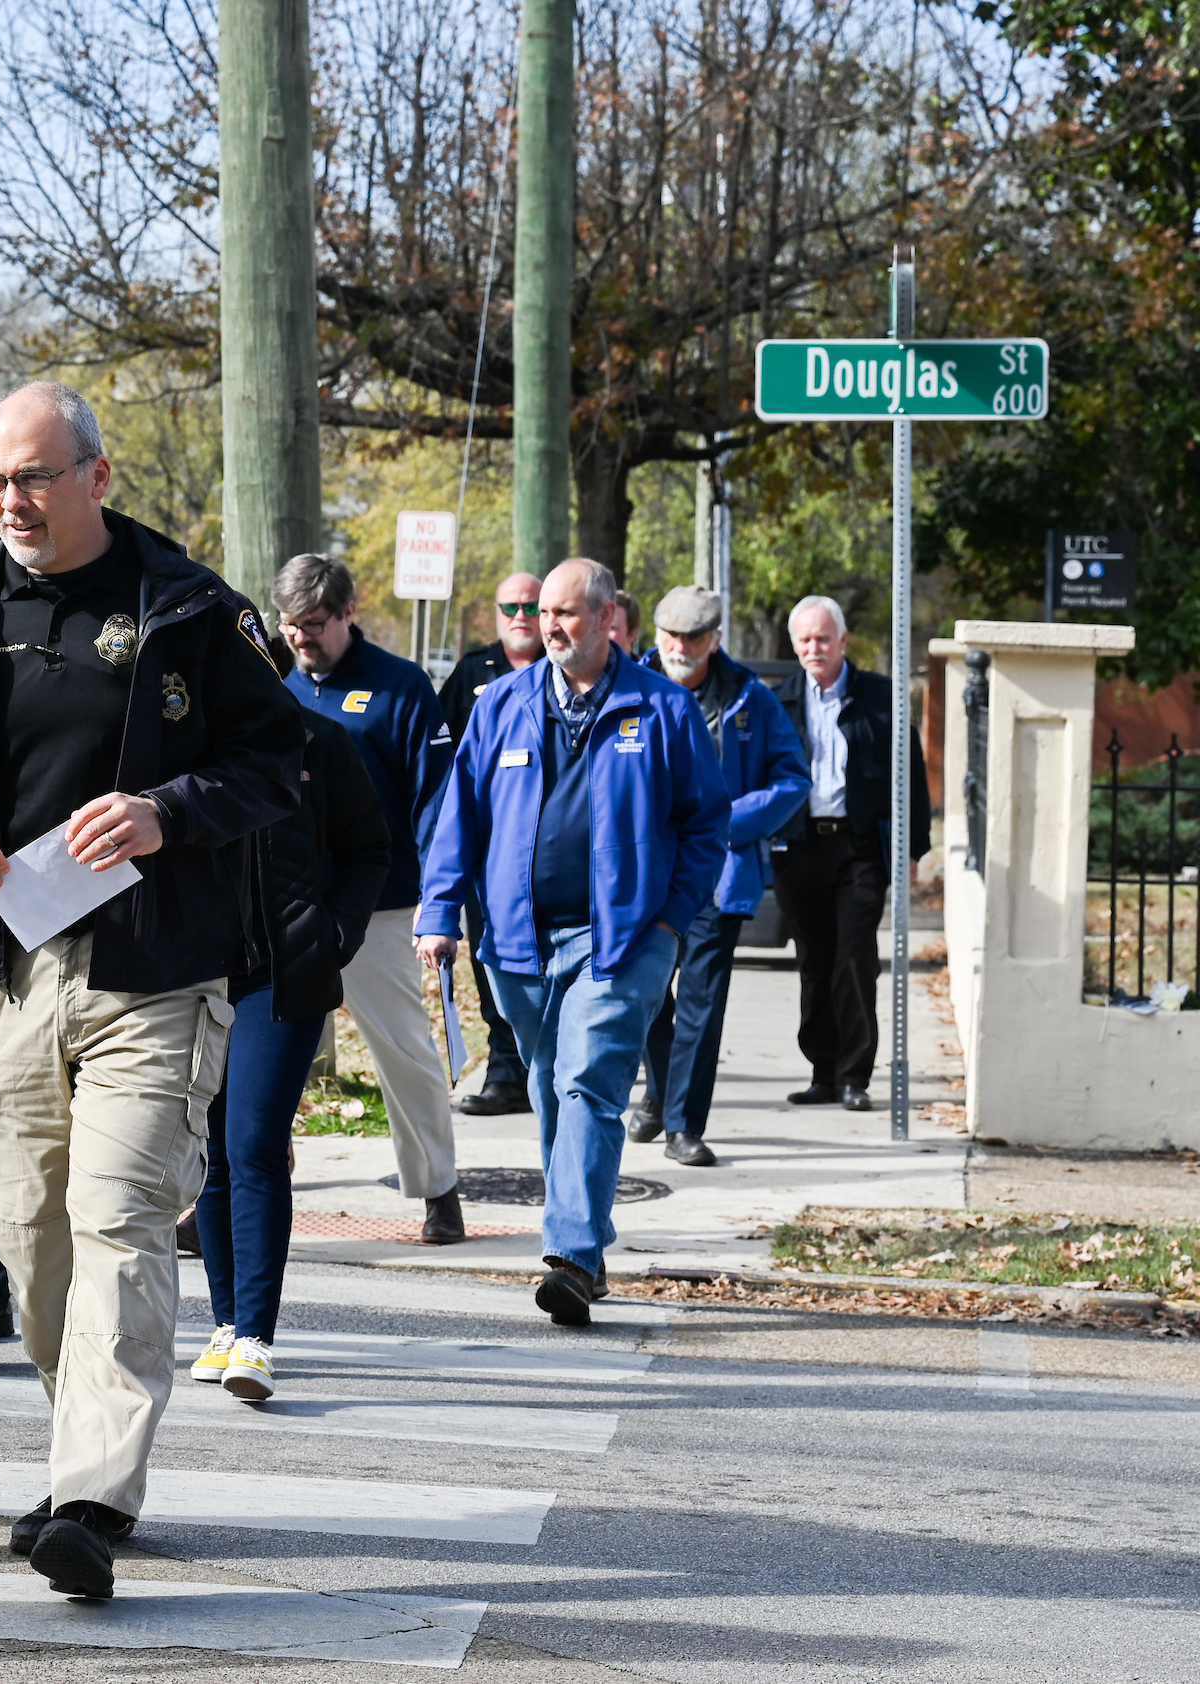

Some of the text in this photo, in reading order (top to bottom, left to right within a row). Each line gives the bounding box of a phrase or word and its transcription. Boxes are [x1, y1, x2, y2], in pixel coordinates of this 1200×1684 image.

[806, 344, 1029, 414] Douglas St
[992, 383, 1042, 415] 600
[415, 519, 437, 536] NO
[400, 537, 450, 555] PARKING
[1064, 535, 1109, 553] UTC
[417, 558, 432, 570] TO
[402, 573, 444, 586] CORNER
[341, 690, 373, 713] C
[618, 716, 641, 737] C
